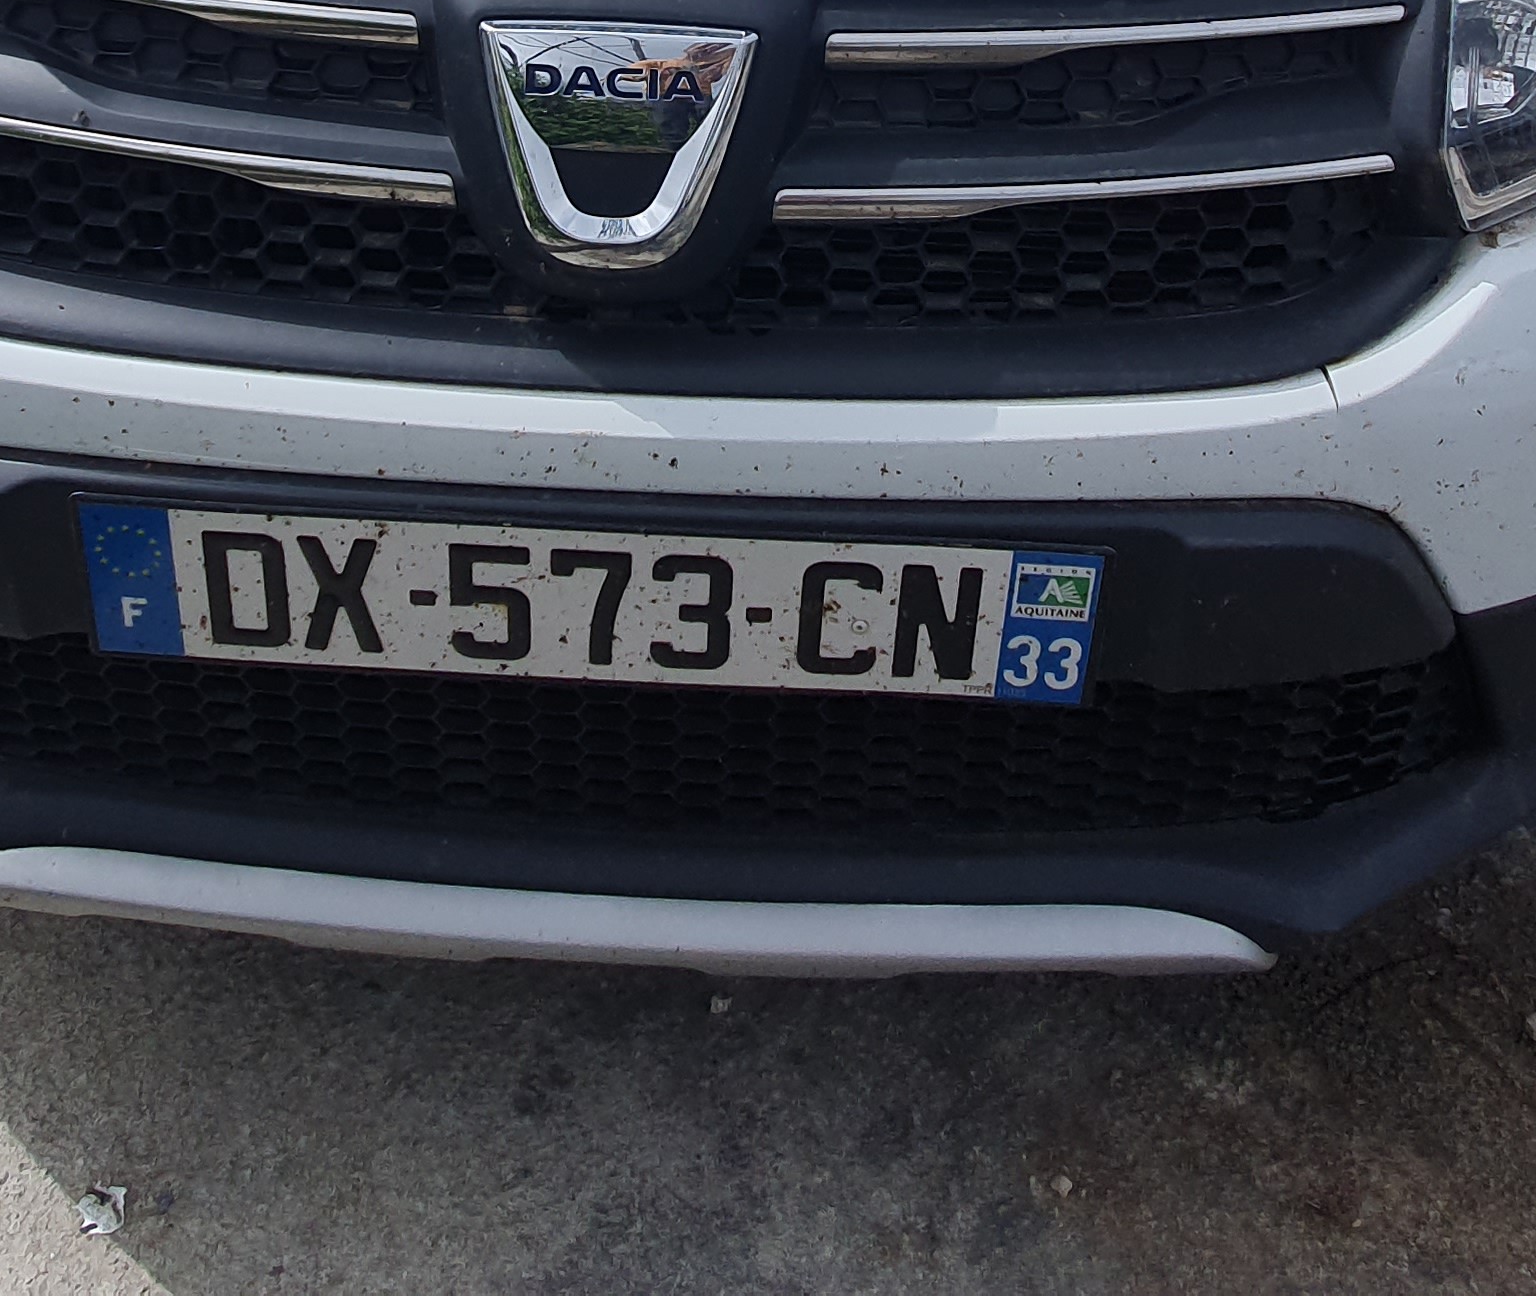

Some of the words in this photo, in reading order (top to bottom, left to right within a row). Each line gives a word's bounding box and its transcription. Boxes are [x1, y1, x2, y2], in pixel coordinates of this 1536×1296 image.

[524, 63, 705, 102] DACIA
[120, 596, 148, 628] F
[201, 530, 984, 681] DX-573-CN
[1014, 605, 1087, 620] AQUITAINE
[1002, 634, 1083, 691] 33
